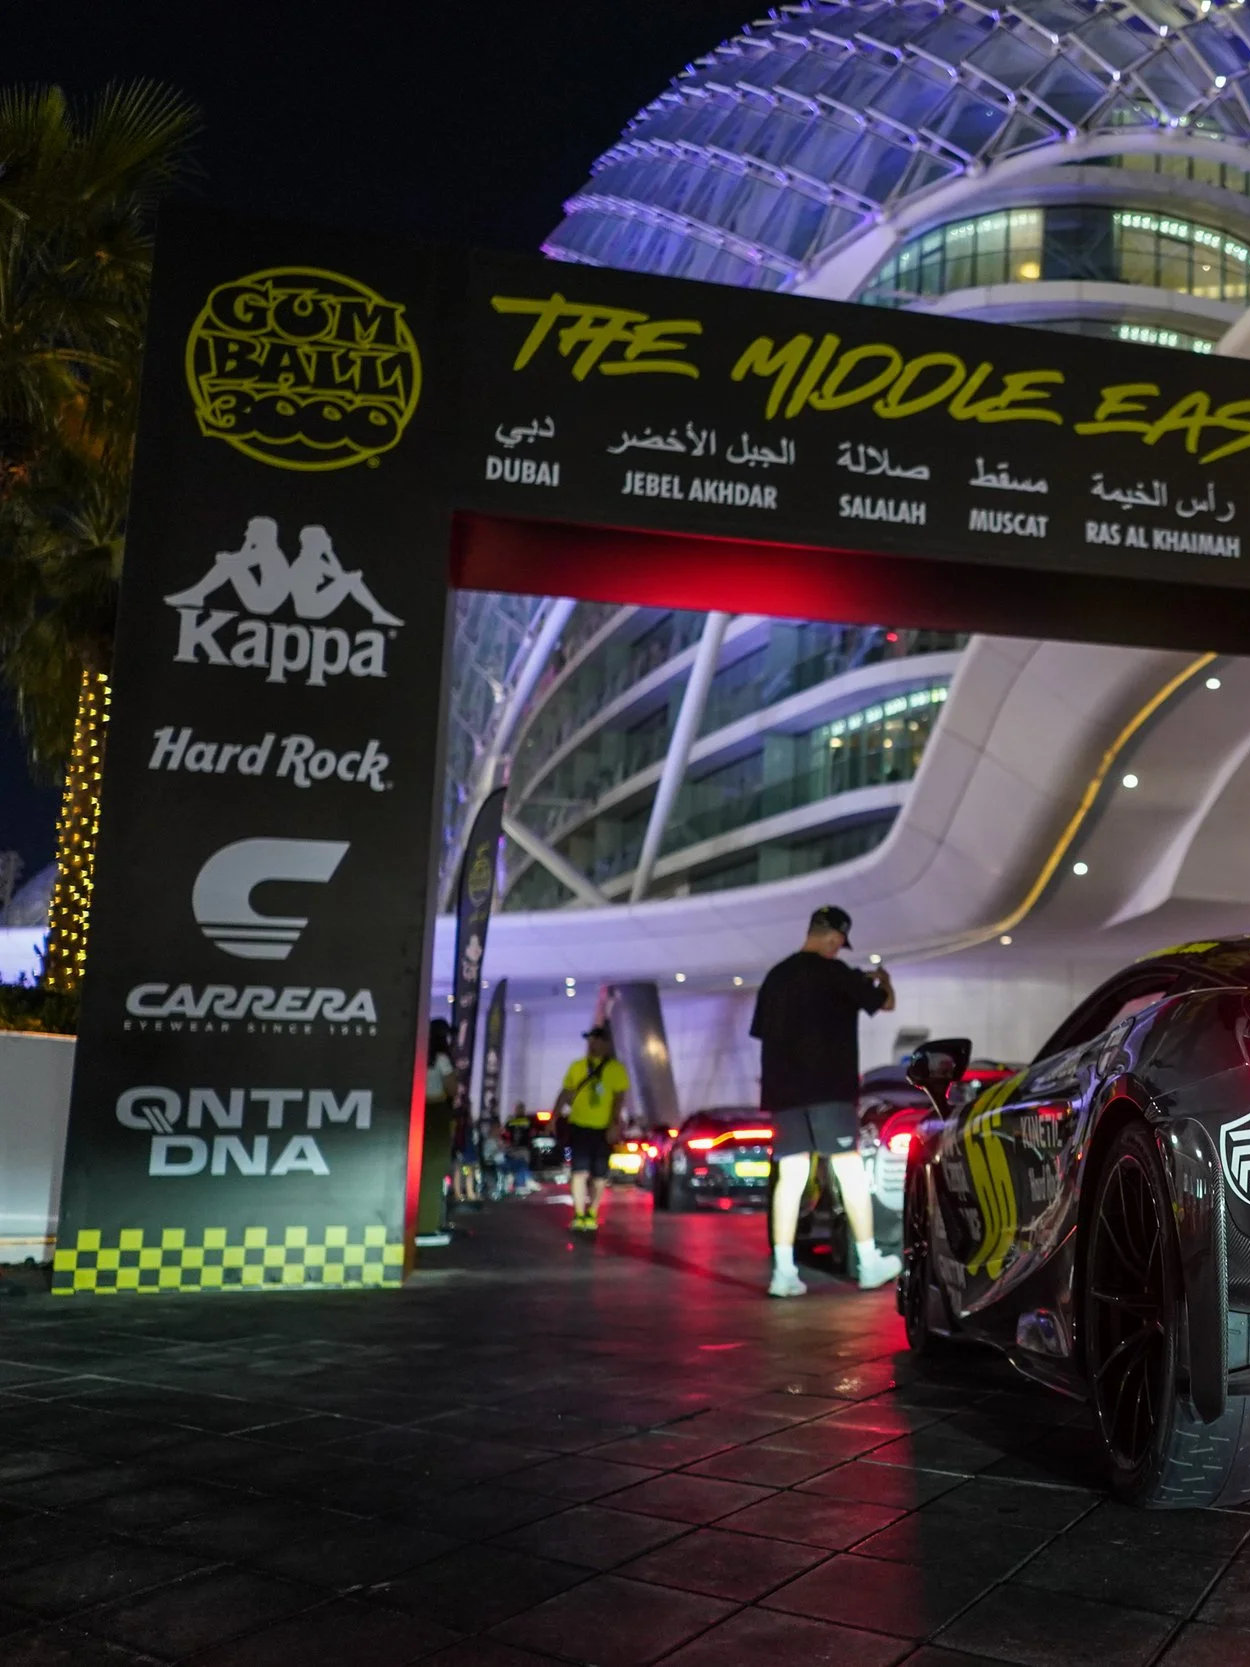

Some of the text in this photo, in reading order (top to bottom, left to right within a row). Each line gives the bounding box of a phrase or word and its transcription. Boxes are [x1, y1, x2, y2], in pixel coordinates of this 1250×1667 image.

[199, 335, 406, 402] BALL
[492, 293, 702, 381] THE
[731, 333, 1064, 424] MIDDLE
[195, 386, 402, 452] 3000
[495, 416, 555, 448] دبي
[607, 420, 796, 469] الجبل الأخضر
[836, 440, 931, 481] صلالة
[485, 456, 560, 488] DUBAI
[621, 469, 778, 511] JEBEL AKHDAR
[970, 457, 1049, 494] مسقط
[838, 494, 927, 526] SALALAH
[1089, 472, 1236, 522] رأس الخيمة
[969, 508, 1049, 538] MUSCAT
[1085, 520, 1241, 559] RAS AL KHAIMAH
[173, 607, 388, 687] Kappa
[148, 726, 391, 792] Hard Rock
[126, 983, 378, 1023] CARRERA
[123, 1019, 230, 1033] EYEWEAR
[247, 1023, 312, 1036] SINCE
[115, 1086, 373, 1133] QNTM
[149, 1135, 330, 1176] DNA
